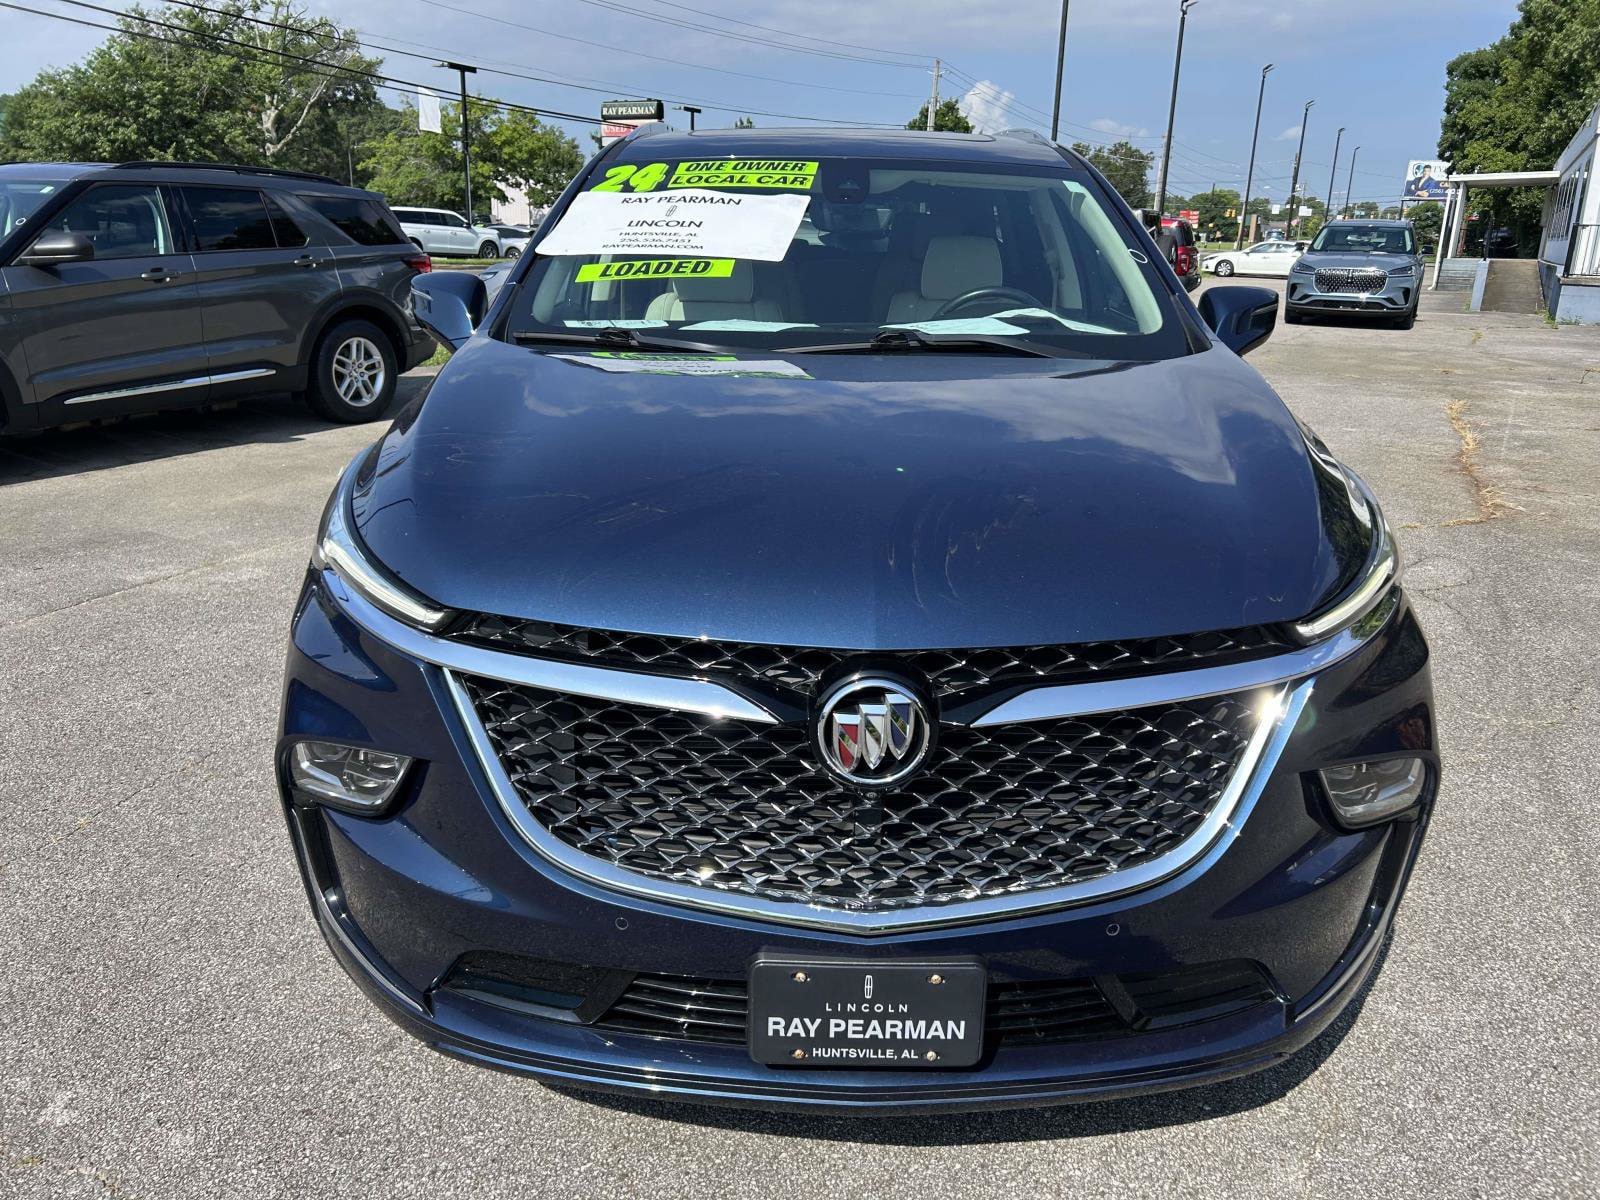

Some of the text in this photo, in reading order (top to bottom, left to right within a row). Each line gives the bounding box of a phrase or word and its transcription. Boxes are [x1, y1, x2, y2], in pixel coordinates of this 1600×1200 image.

[603, 105, 655, 115] RAY PEARMAN
[604, 125, 627, 133] USED
[685, 161, 807, 172] ONE OWNER
[590, 162, 669, 192] 24
[671, 174, 809, 186] LOCAL CAR
[657, 195, 742, 205] PEARMAN
[627, 220, 703, 228] LINCOLN
[599, 260, 712, 277] LOADED
[826, 1002, 908, 1013] LINCOLN
[767, 1017, 965, 1040] RAY PEARMAN
[812, 1047, 919, 1060] HUNTSVILLE, AL
